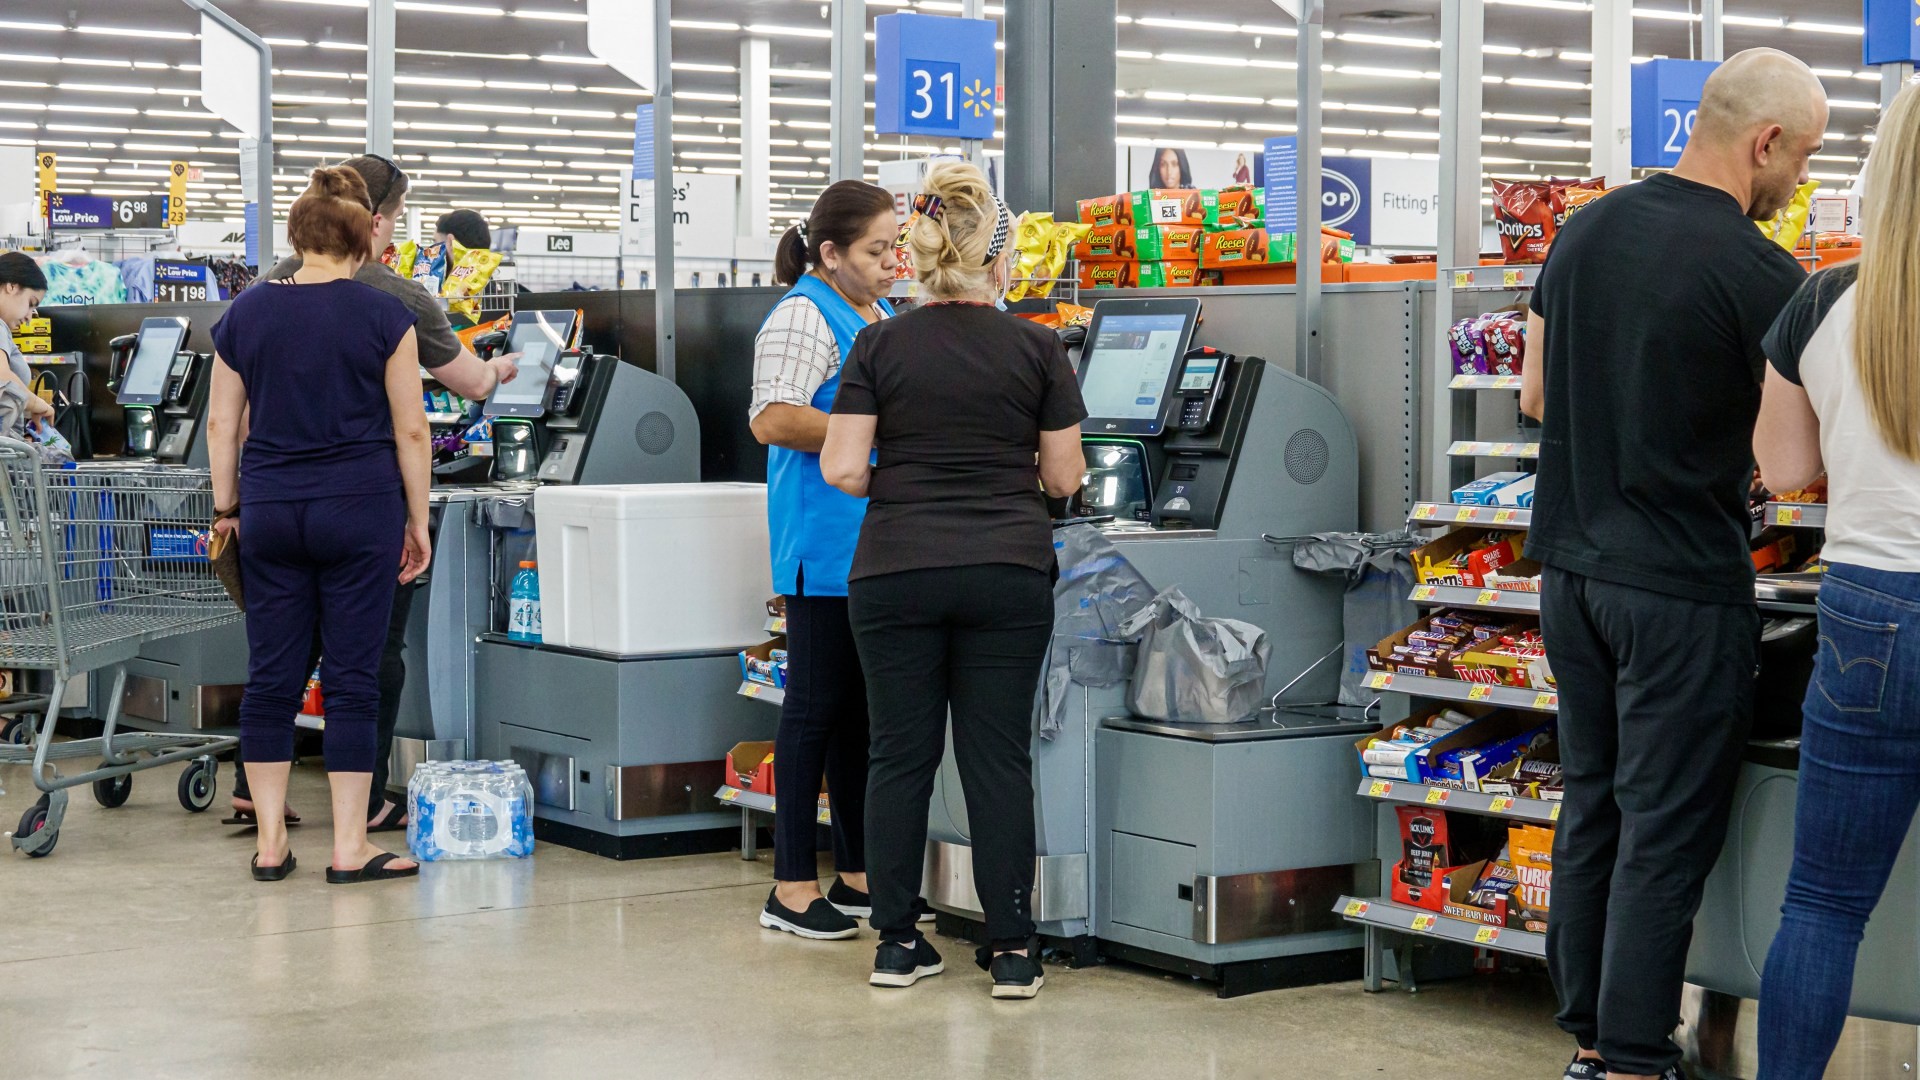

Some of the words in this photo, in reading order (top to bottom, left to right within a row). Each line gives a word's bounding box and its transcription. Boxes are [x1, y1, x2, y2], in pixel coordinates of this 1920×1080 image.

[911, 69, 953, 120] 31
[172, 197, 183, 208] D
[1321, 191, 1351, 207] OP
[1383, 193, 1428, 214] Fitting
[1090, 202, 1113, 216] Reese's
[1219, 201, 1237, 210] eese's
[53, 213, 73, 222] Low
[75, 213, 99, 223] Price
[171, 212, 184, 222] 23
[1496, 220, 1543, 237] Doritos
[220, 232, 246, 242] AV
[1086, 231, 1112, 244] Reese's
[1168, 231, 1190, 240] Reese's
[551, 236, 570, 250] Lee
[1216, 235, 1245, 249] Reese's
[182, 269, 197, 277] Price
[1090, 265, 1118, 279] Reese's
[1170, 266, 1193, 275] Reese's
[62, 295, 95, 305] MOM
[1176, 486, 1184, 494] 37
[1483, 549, 1501, 563] SHARE
[1399, 667, 1425, 676] SNICKERS
[1521, 760, 1562, 775] HERSHEY'S
[1424, 776, 1451, 788] Almond
[1443, 905, 1464, 917] SWEET
[1465, 909, 1483, 920] BABY
[1483, 912, 1502, 925] RAY'S
[1570, 1063, 1588, 1074] NIKE
